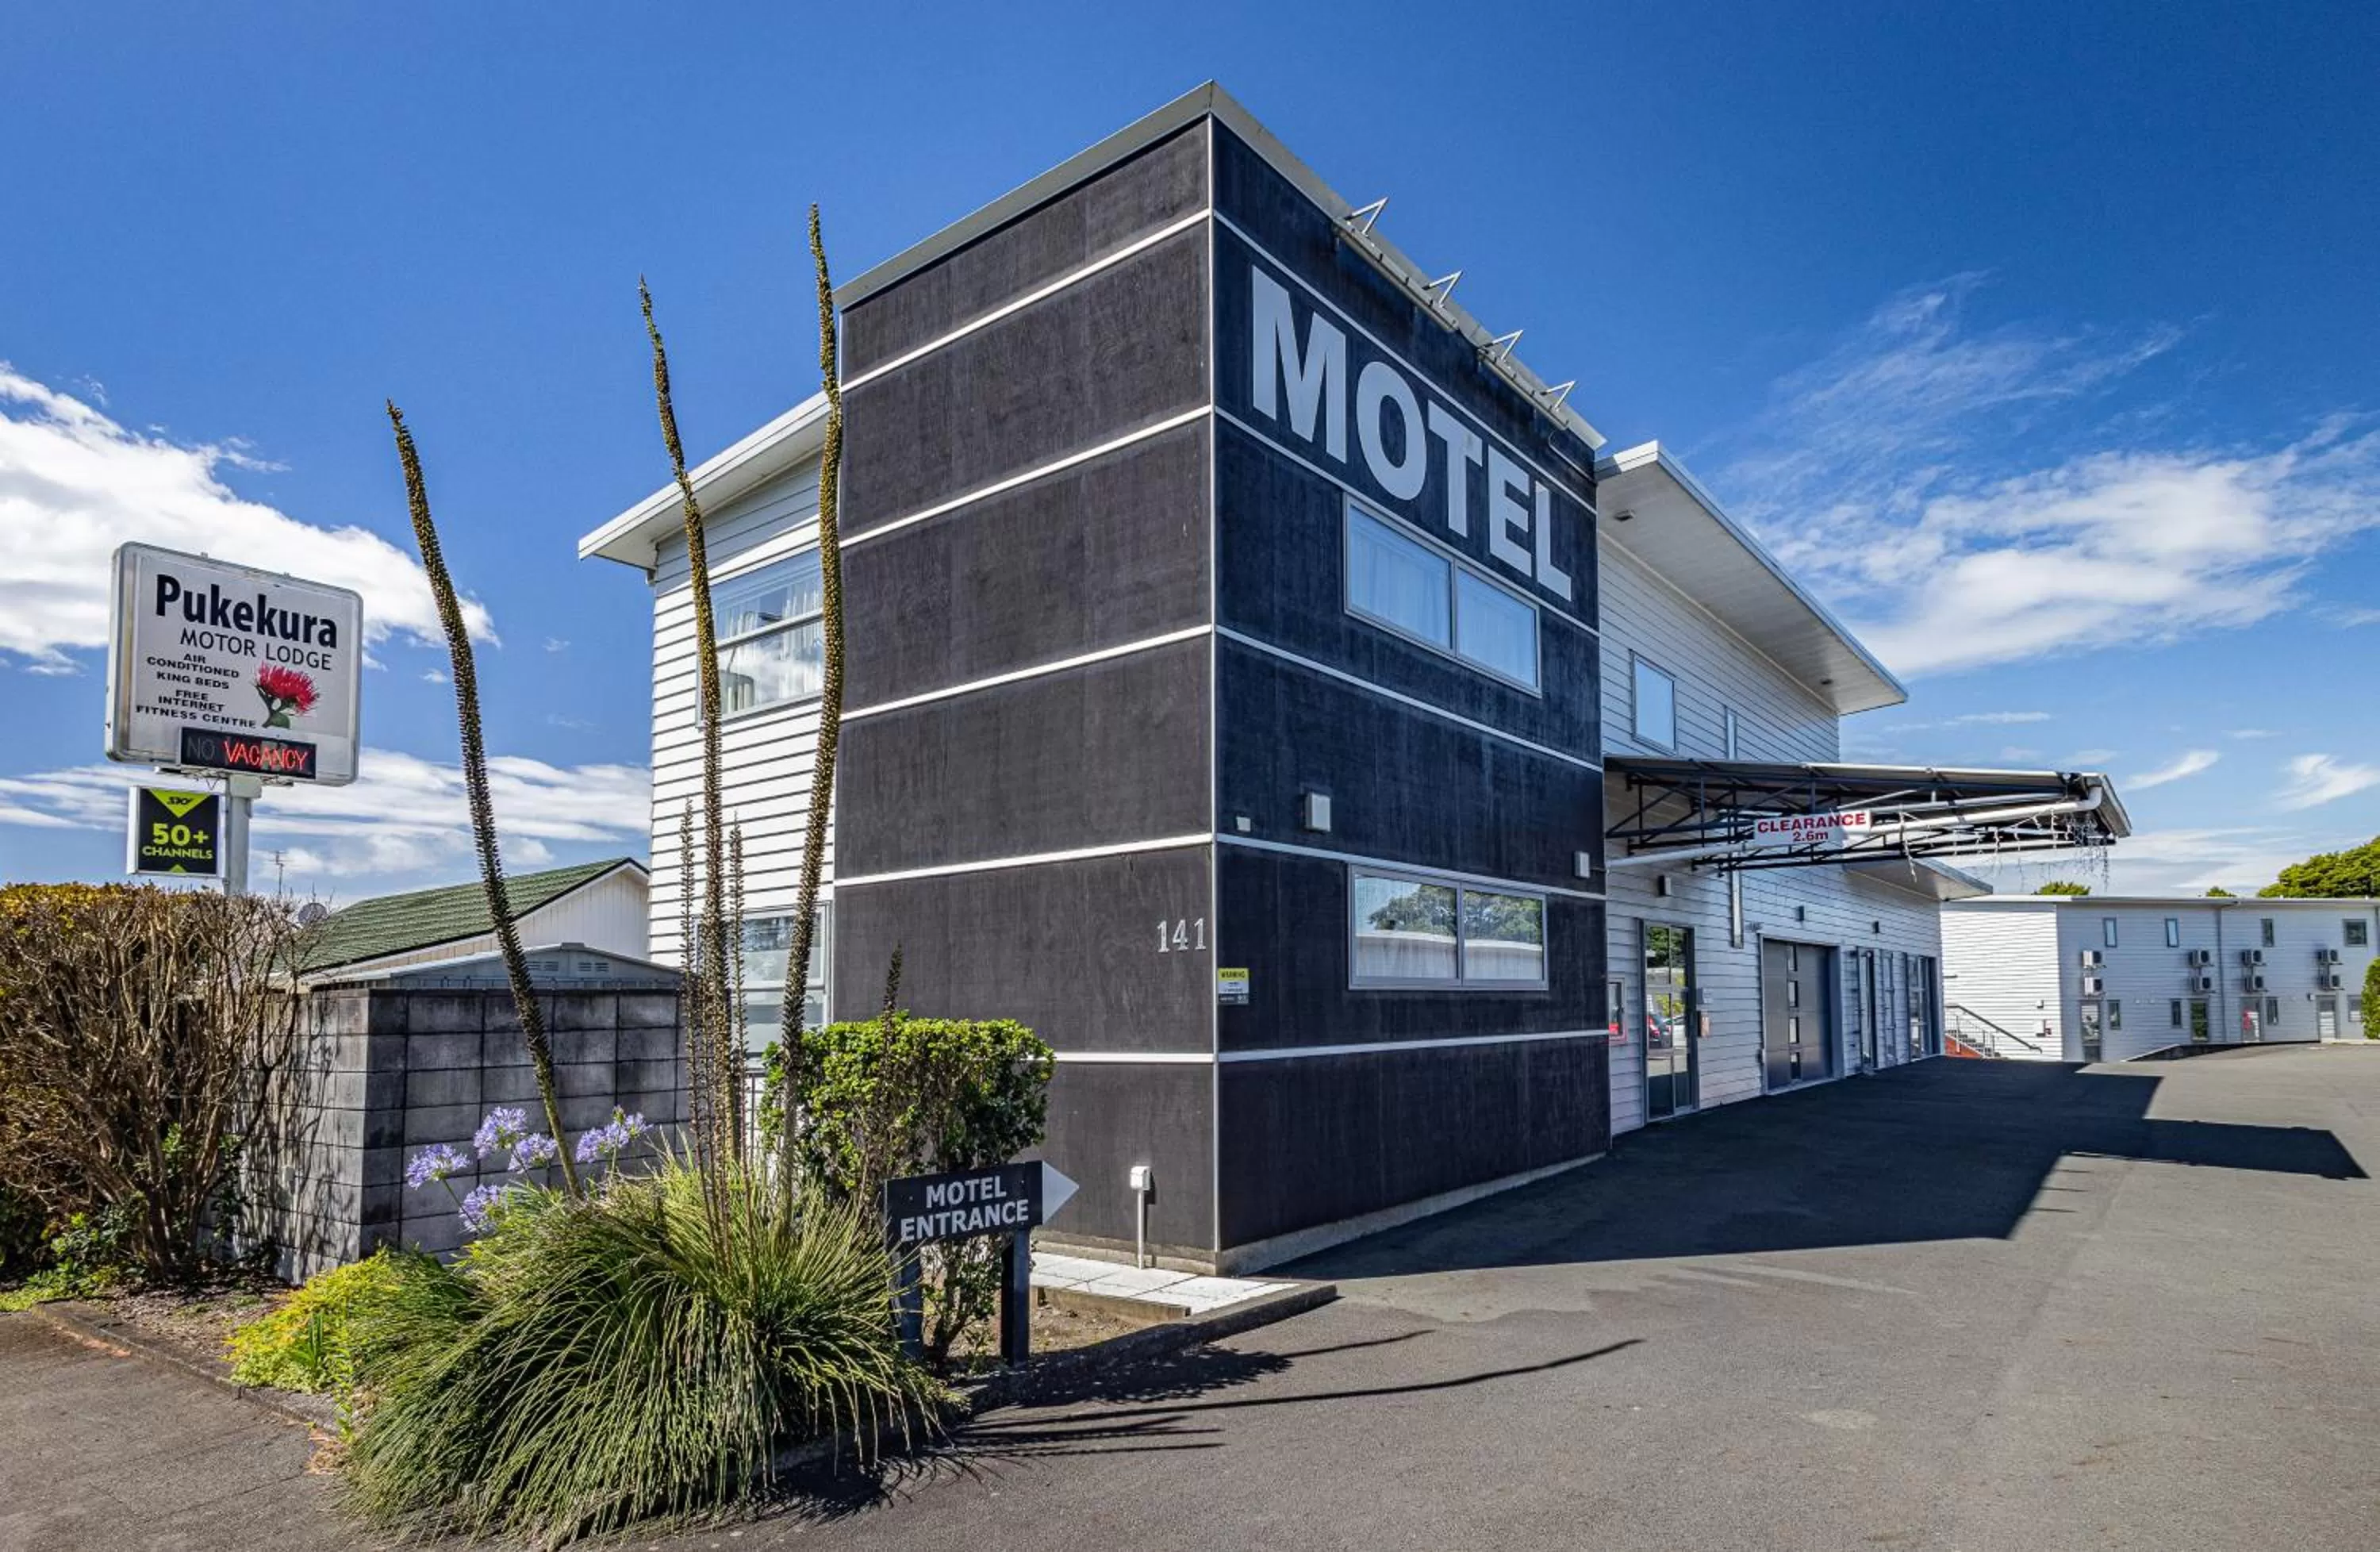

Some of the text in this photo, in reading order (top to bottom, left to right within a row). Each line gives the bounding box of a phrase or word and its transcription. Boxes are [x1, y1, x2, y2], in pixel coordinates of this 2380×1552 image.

[1253, 264, 1572, 601] MOTEL
[155, 574, 337, 649] Pukekura
[180, 628, 332, 670] MOTOR LODGE
[183, 653, 206, 664] AIR
[147, 656, 240, 678] CONDITIONED
[156, 671, 229, 690] KING BEDS
[158, 696, 225, 713] INTERNET
[175, 690, 209, 701] FREE
[136, 705, 256, 729] FITNESS CENTRE
[186, 736, 308, 771] NO VACANCY
[1757, 812, 1866, 832] CLEARANCE
[153, 823, 209, 846] 50+
[1793, 831, 1829, 842] 2.6m
[142, 845, 213, 859] CHANNELS
[1157, 917, 1206, 952] 141
[926, 1175, 1007, 1208] MOTEL
[900, 1199, 1029, 1243] ENTRANCE
